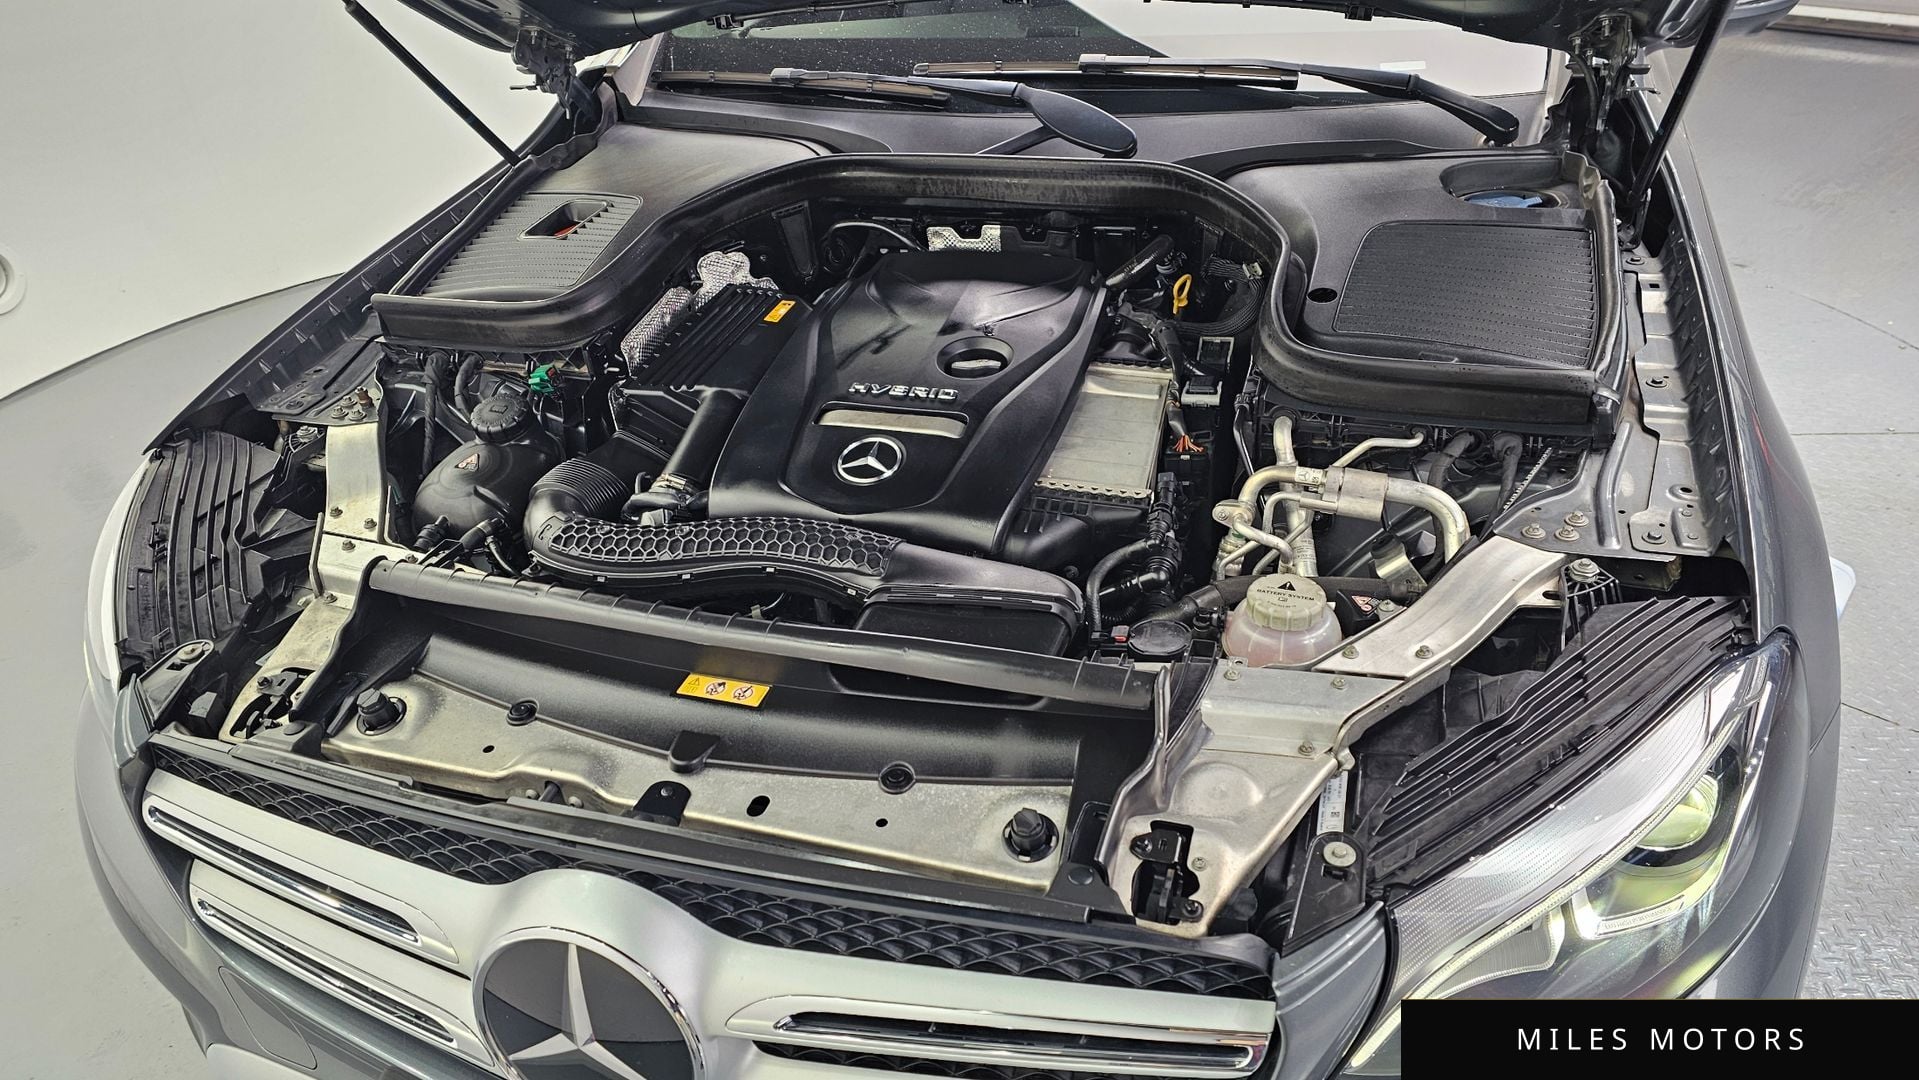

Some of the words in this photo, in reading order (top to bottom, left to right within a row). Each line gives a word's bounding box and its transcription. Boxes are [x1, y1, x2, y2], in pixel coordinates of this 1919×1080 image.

[848, 381, 959, 400] HYBRID
[1256, 588, 1286, 597] BATTERY
[1287, 593, 1315, 601] SYSTEM
